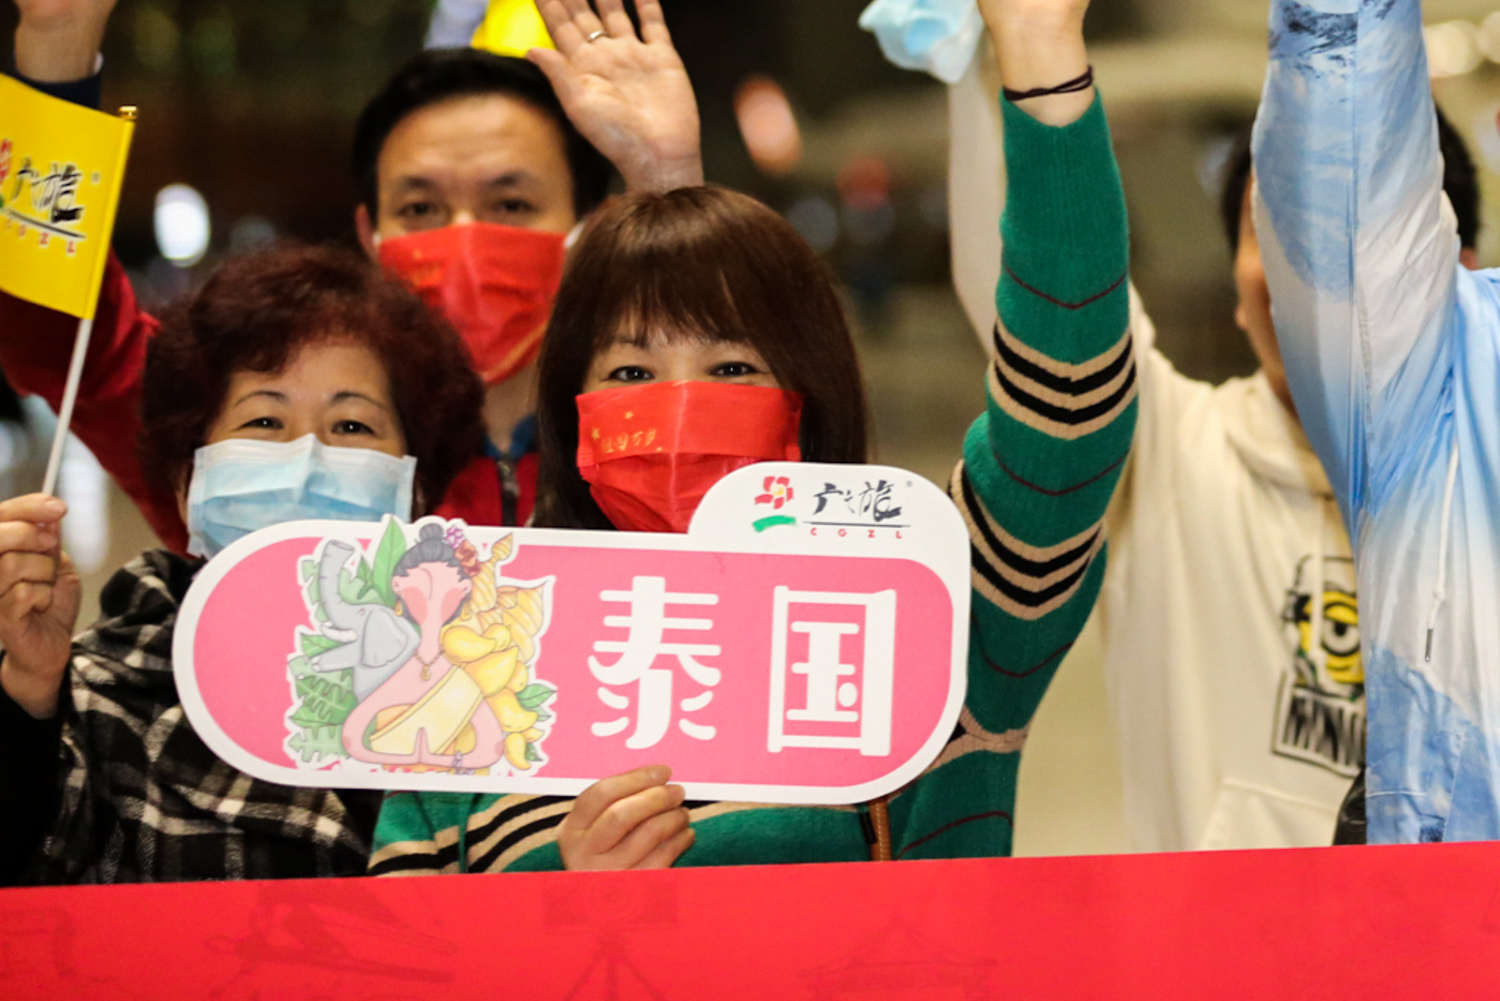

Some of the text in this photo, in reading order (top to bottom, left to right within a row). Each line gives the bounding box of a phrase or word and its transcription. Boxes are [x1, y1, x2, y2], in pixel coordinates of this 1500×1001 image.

[813, 479, 902, 522] 广之旅
[587, 575, 897, 757] 泰国
